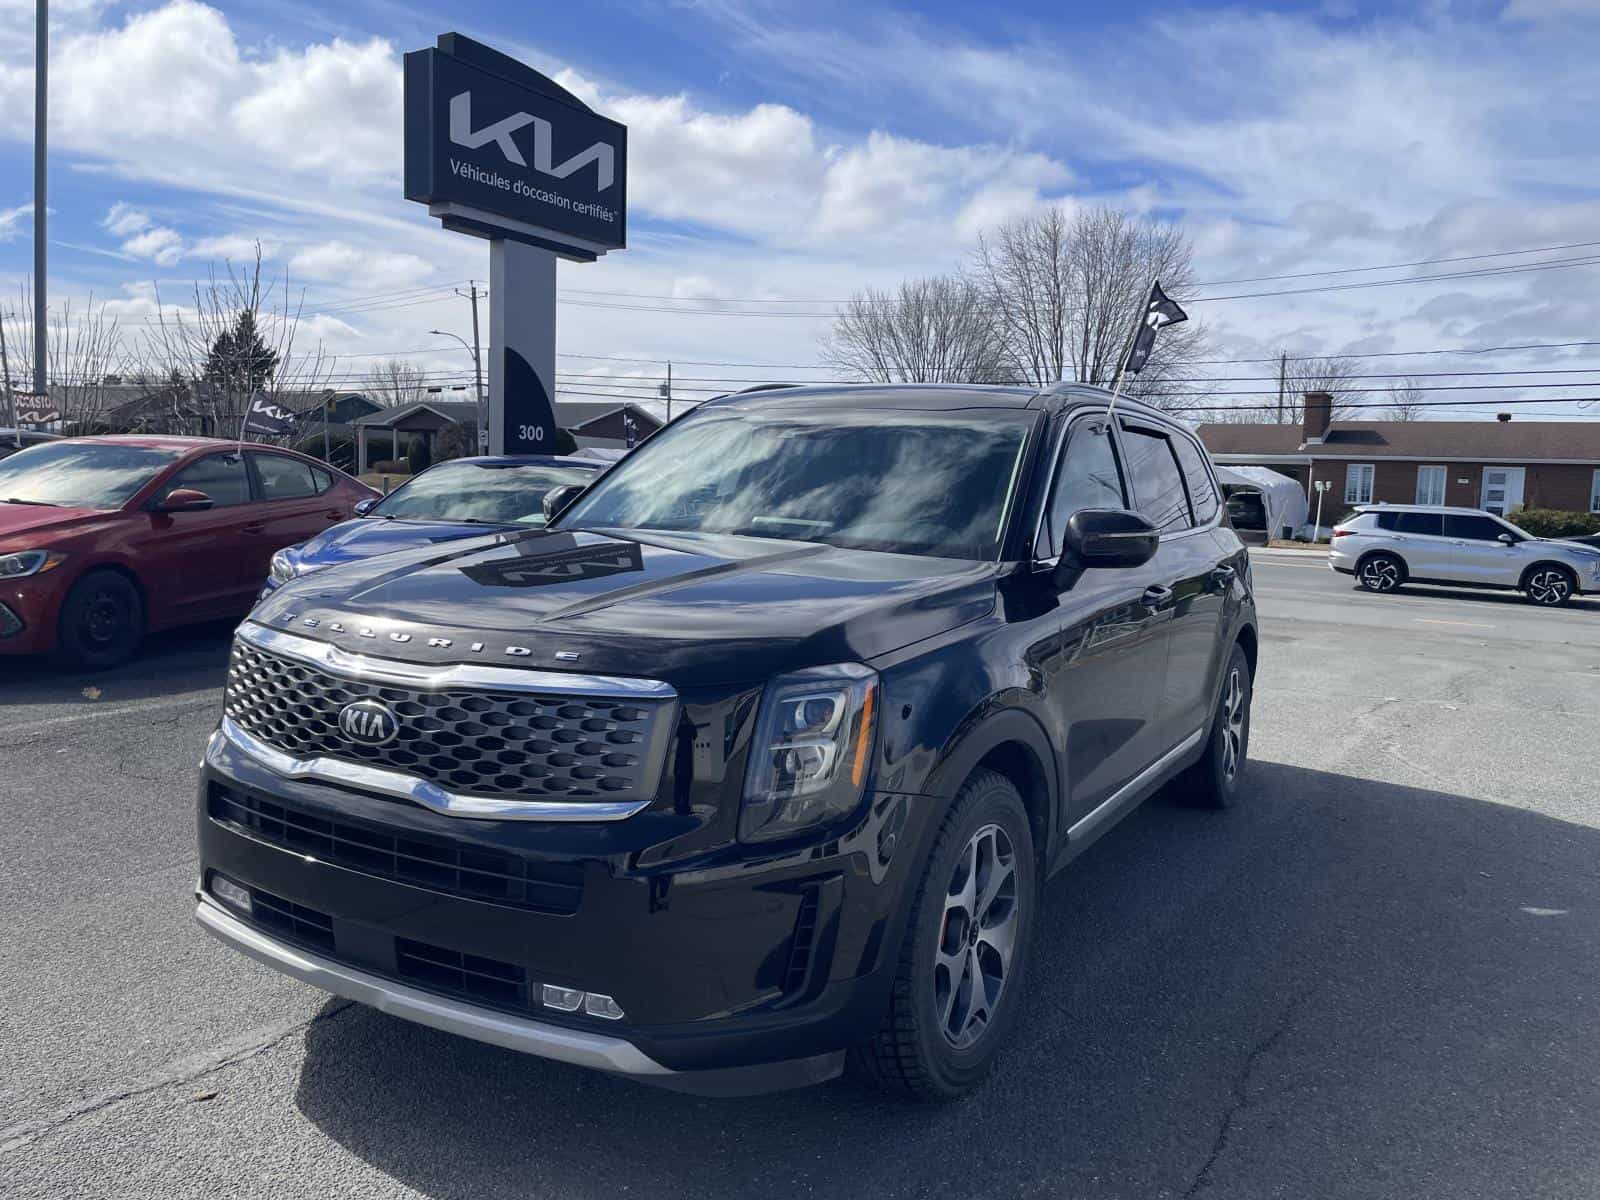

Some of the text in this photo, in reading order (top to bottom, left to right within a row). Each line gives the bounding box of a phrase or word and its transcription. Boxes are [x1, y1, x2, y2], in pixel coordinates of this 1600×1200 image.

[450, 90, 615, 192] KIA
[450, 158, 511, 191] Véhicules
[513, 180, 570, 210] d'occasion
[519, 425, 544, 441] 300
[283, 612, 583, 662] TELLURIDE
[345, 709, 385, 738] KIA
